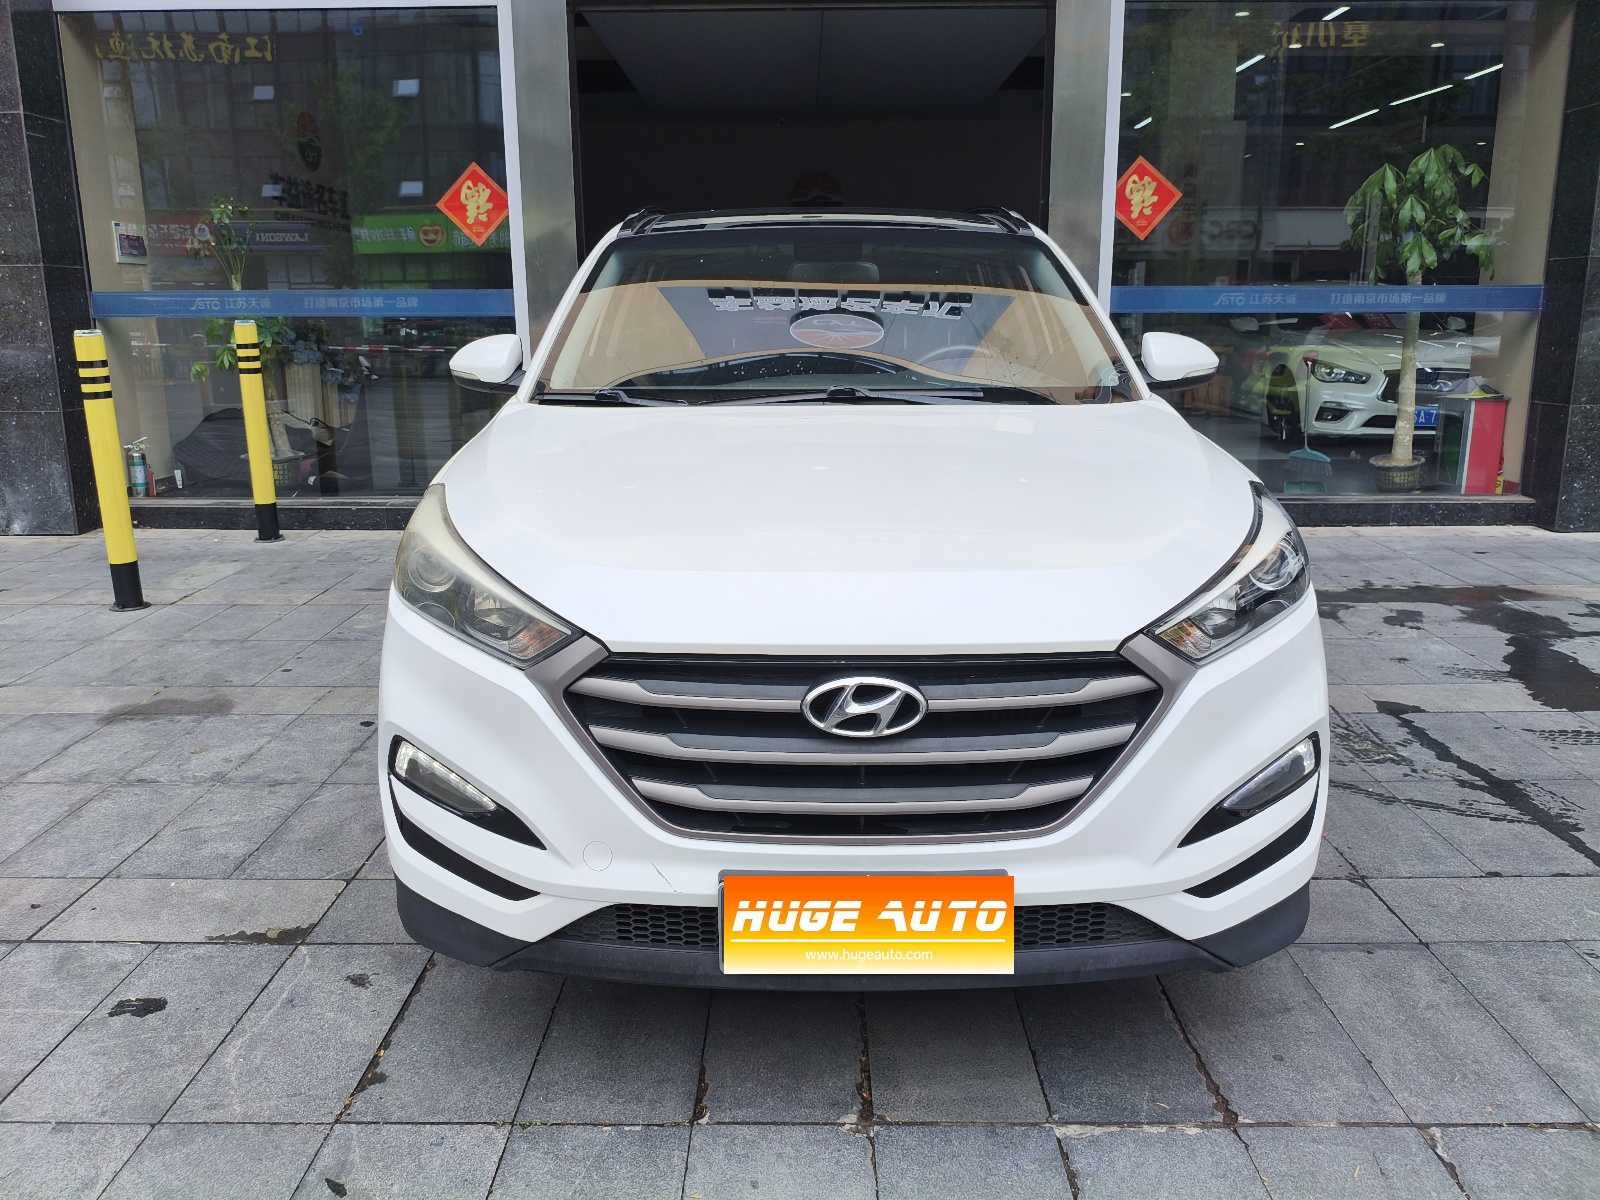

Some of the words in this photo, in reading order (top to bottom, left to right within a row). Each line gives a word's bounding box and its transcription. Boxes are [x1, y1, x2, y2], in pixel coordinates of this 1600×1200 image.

[303, 296, 419, 309] 打造南京市场第一品牌
[1330, 292, 1447, 305] 打造南京市场第一品牌
[1413, 410, 1437, 424] A·7
